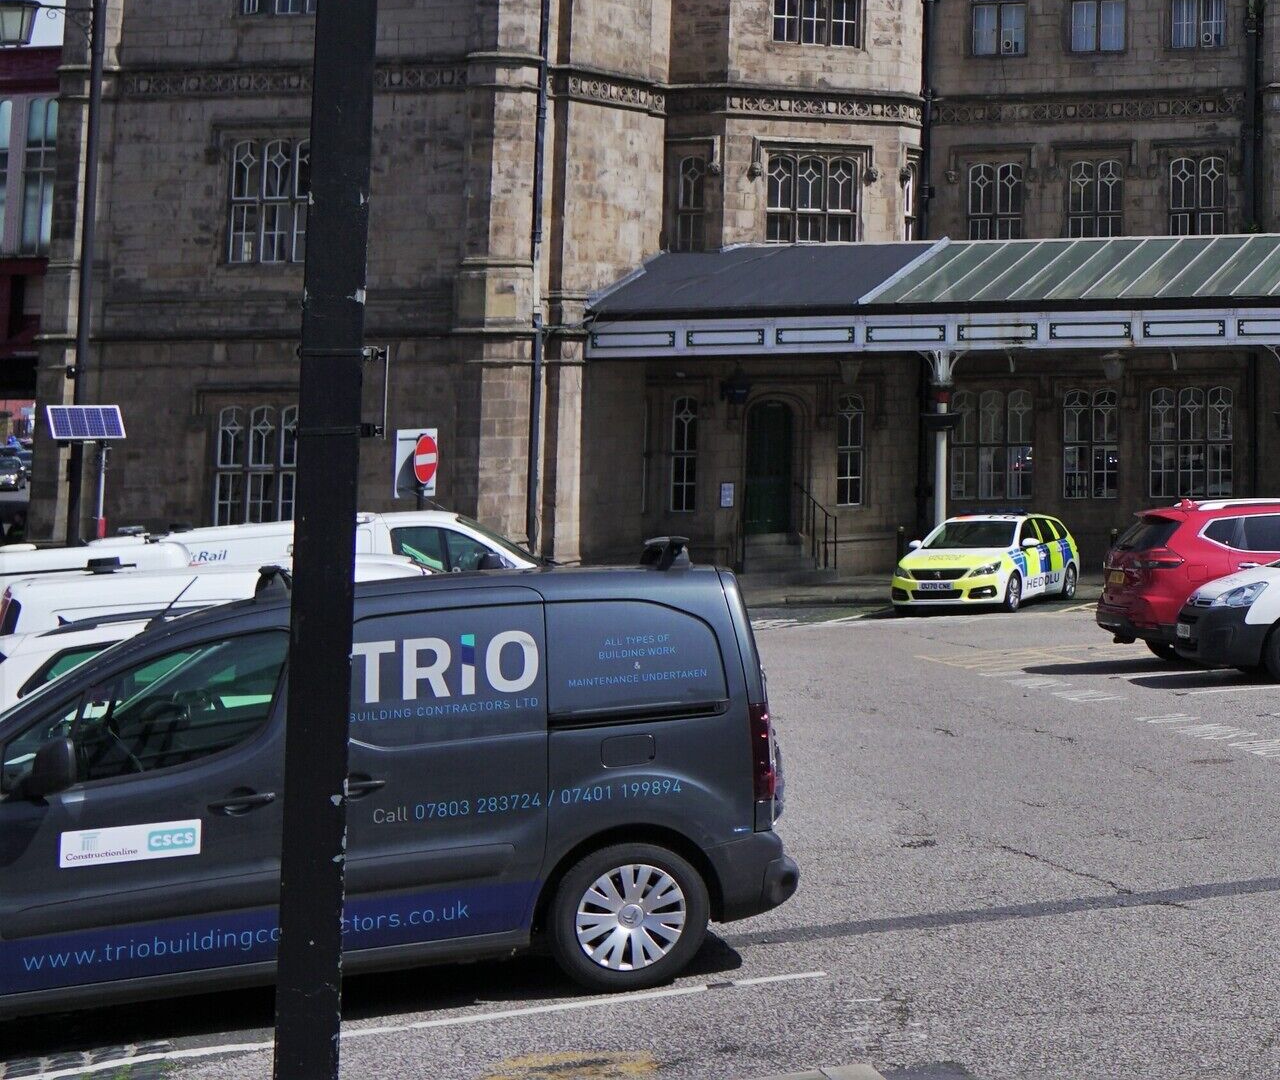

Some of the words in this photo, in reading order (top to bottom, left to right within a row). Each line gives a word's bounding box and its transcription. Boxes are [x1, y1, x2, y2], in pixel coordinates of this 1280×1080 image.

[1026, 573, 1060, 591] HEDDLU
[604, 638, 622, 647] ALL
[626, 634, 655, 645] TYPES
[657, 634, 671, 643] OF
[598, 648, 646, 660] BUILDING
[647, 646, 677, 656] WORK
[634, 661, 640, 670] &
[568, 675, 639, 689] MAINTENANCE
[642, 668, 707, 682] UNDERTAKEN
[416, 700, 511, 717] CONTRACTORS
[515, 697, 539, 709] LTD
[373, 807, 408, 824] Call
[415, 799, 470, 820] 07803
[477, 792, 541, 814] 283724
[547, 788, 555, 807] /
[560, 784, 612, 804] 07401
[621, 778, 682, 799] 199894
[65, 848, 138, 861] Constructionline
[23, 900, 469, 972] www.triobuildingcoctors.co.uk
